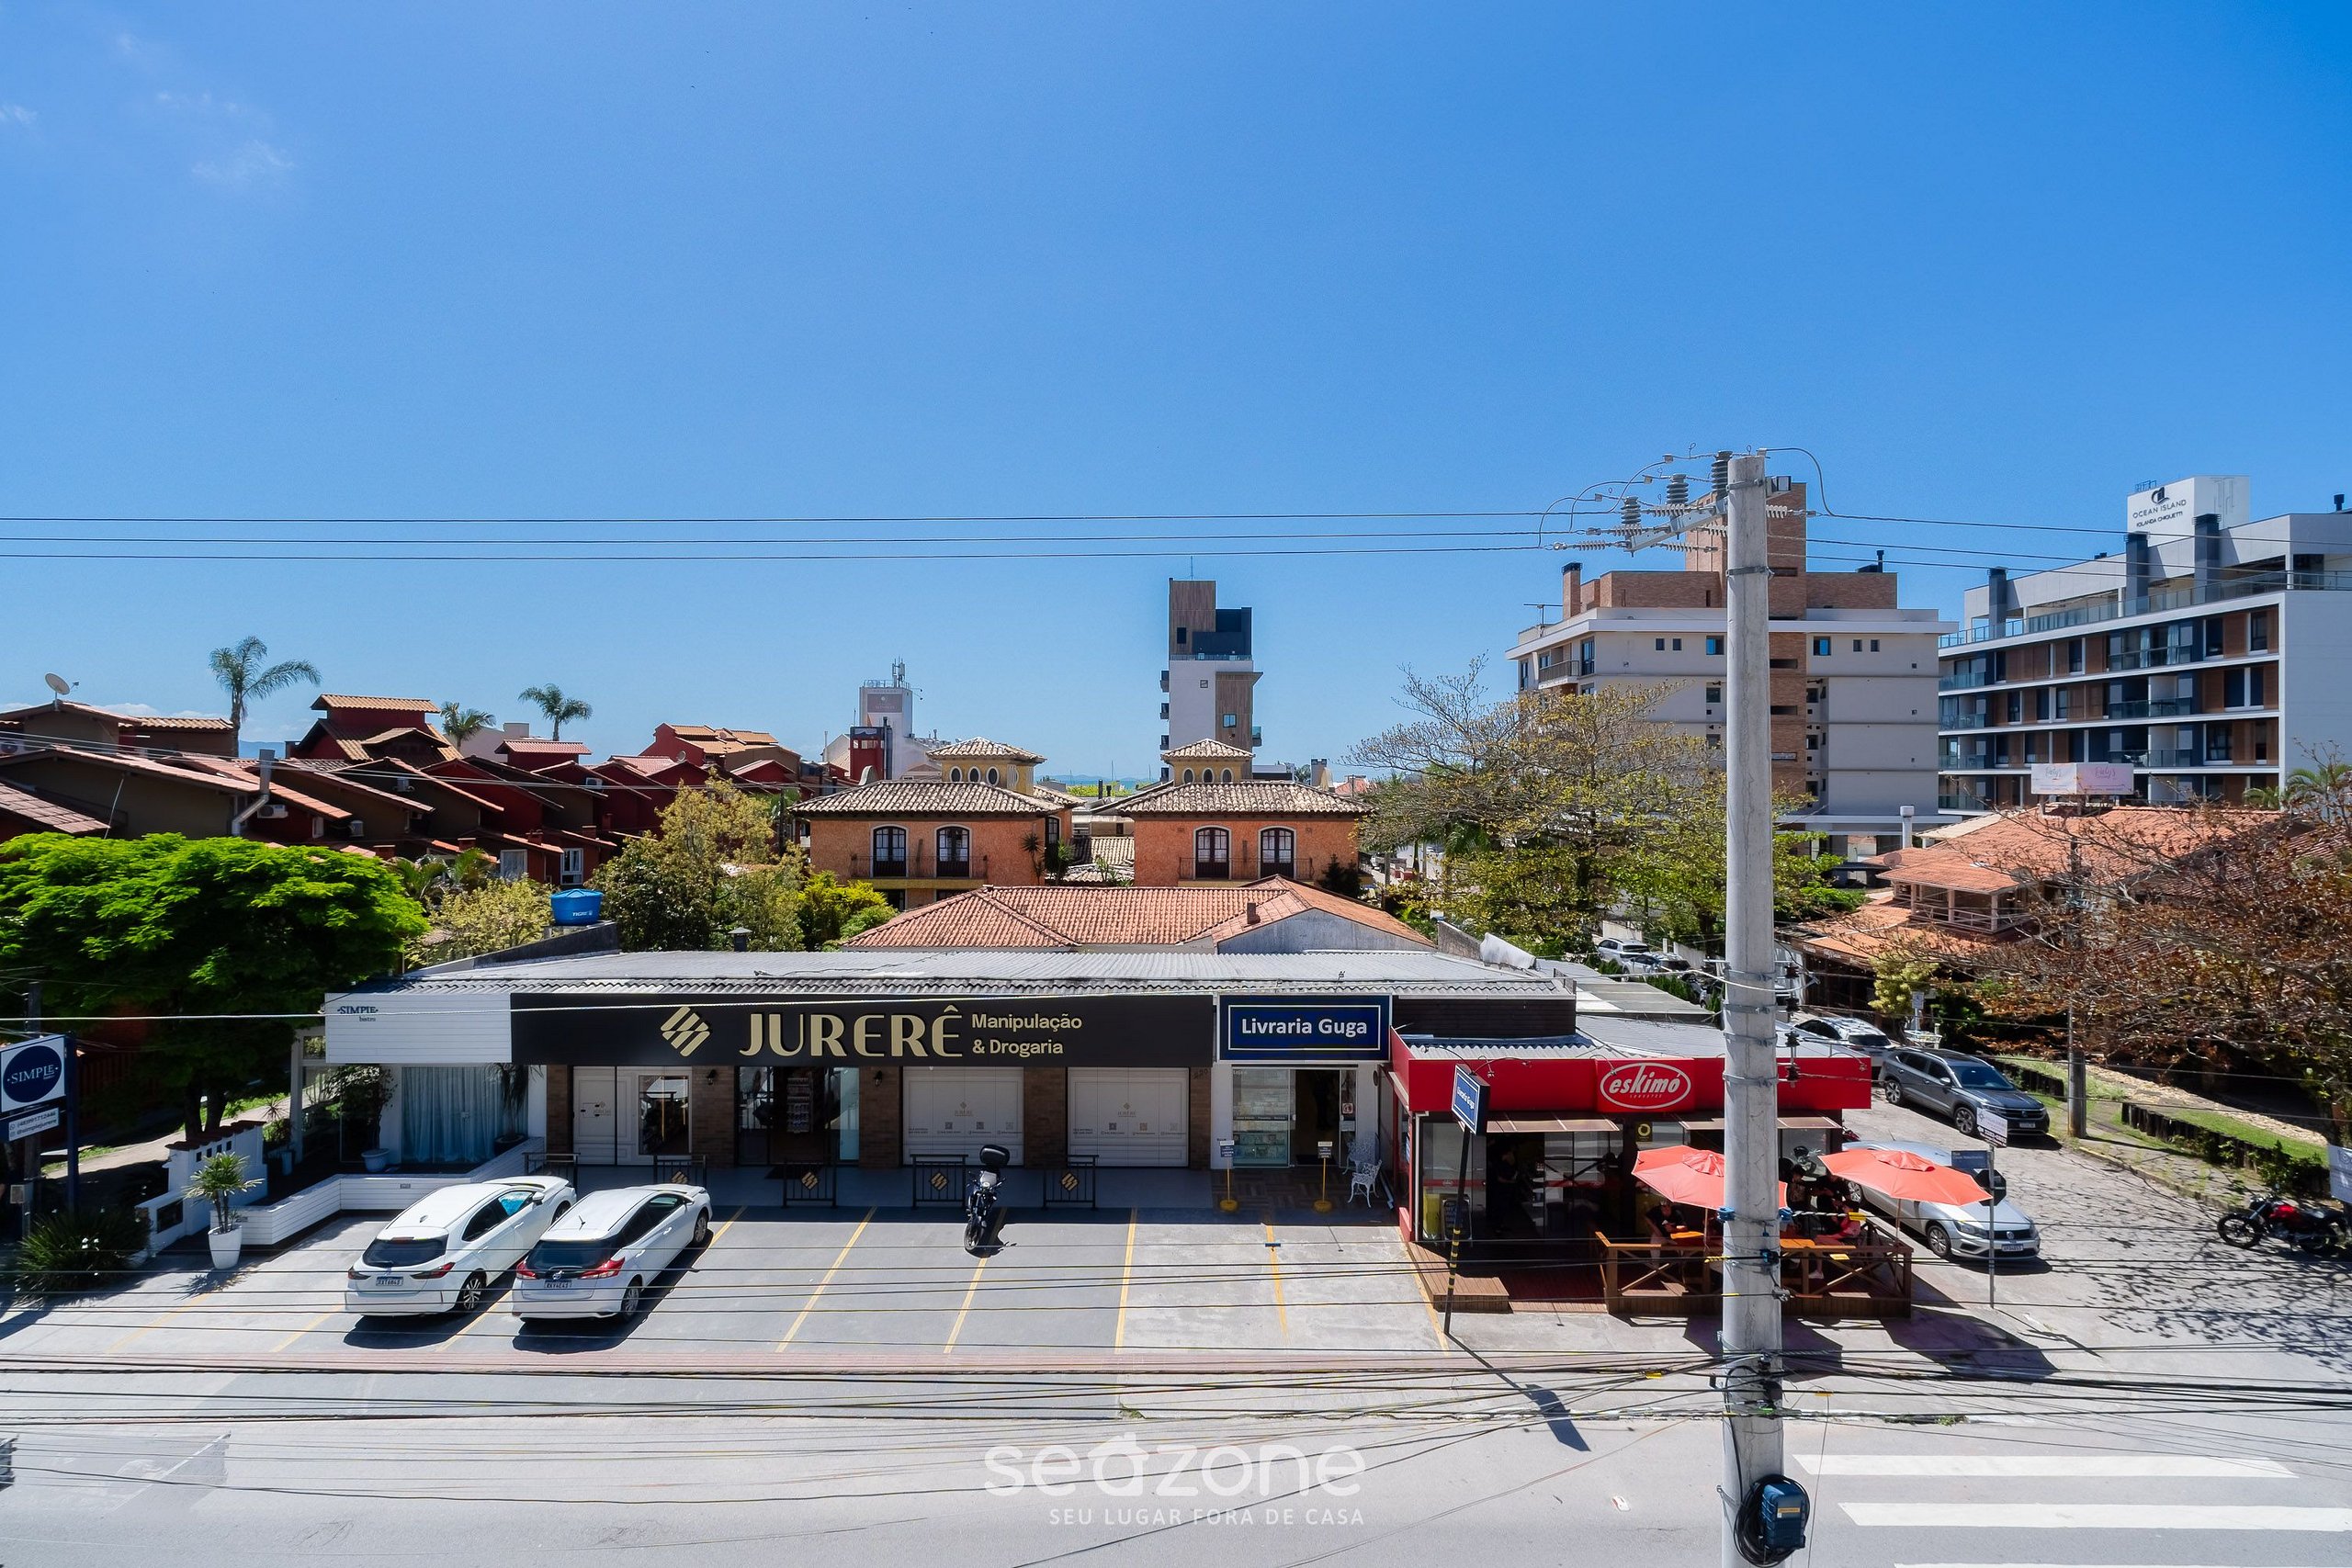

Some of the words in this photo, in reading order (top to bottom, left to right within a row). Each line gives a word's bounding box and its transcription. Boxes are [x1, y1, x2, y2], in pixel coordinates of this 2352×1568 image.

[2132, 507, 2158, 519] OCEAN
[2160, 499, 2187, 511] ISLAND
[739, 1004, 963, 1057] JURERÊ
[971, 1013, 1083, 1032] Manipulação
[1241, 1018, 1312, 1034] Livraria
[1318, 1018, 1367, 1038] Guga
[972, 1039, 985, 1055] &
[989, 1039, 1064, 1058] Drogaria
[11, 1064, 55, 1085] SIMPLE
[1609, 1066, 1680, 1094] eskimó
